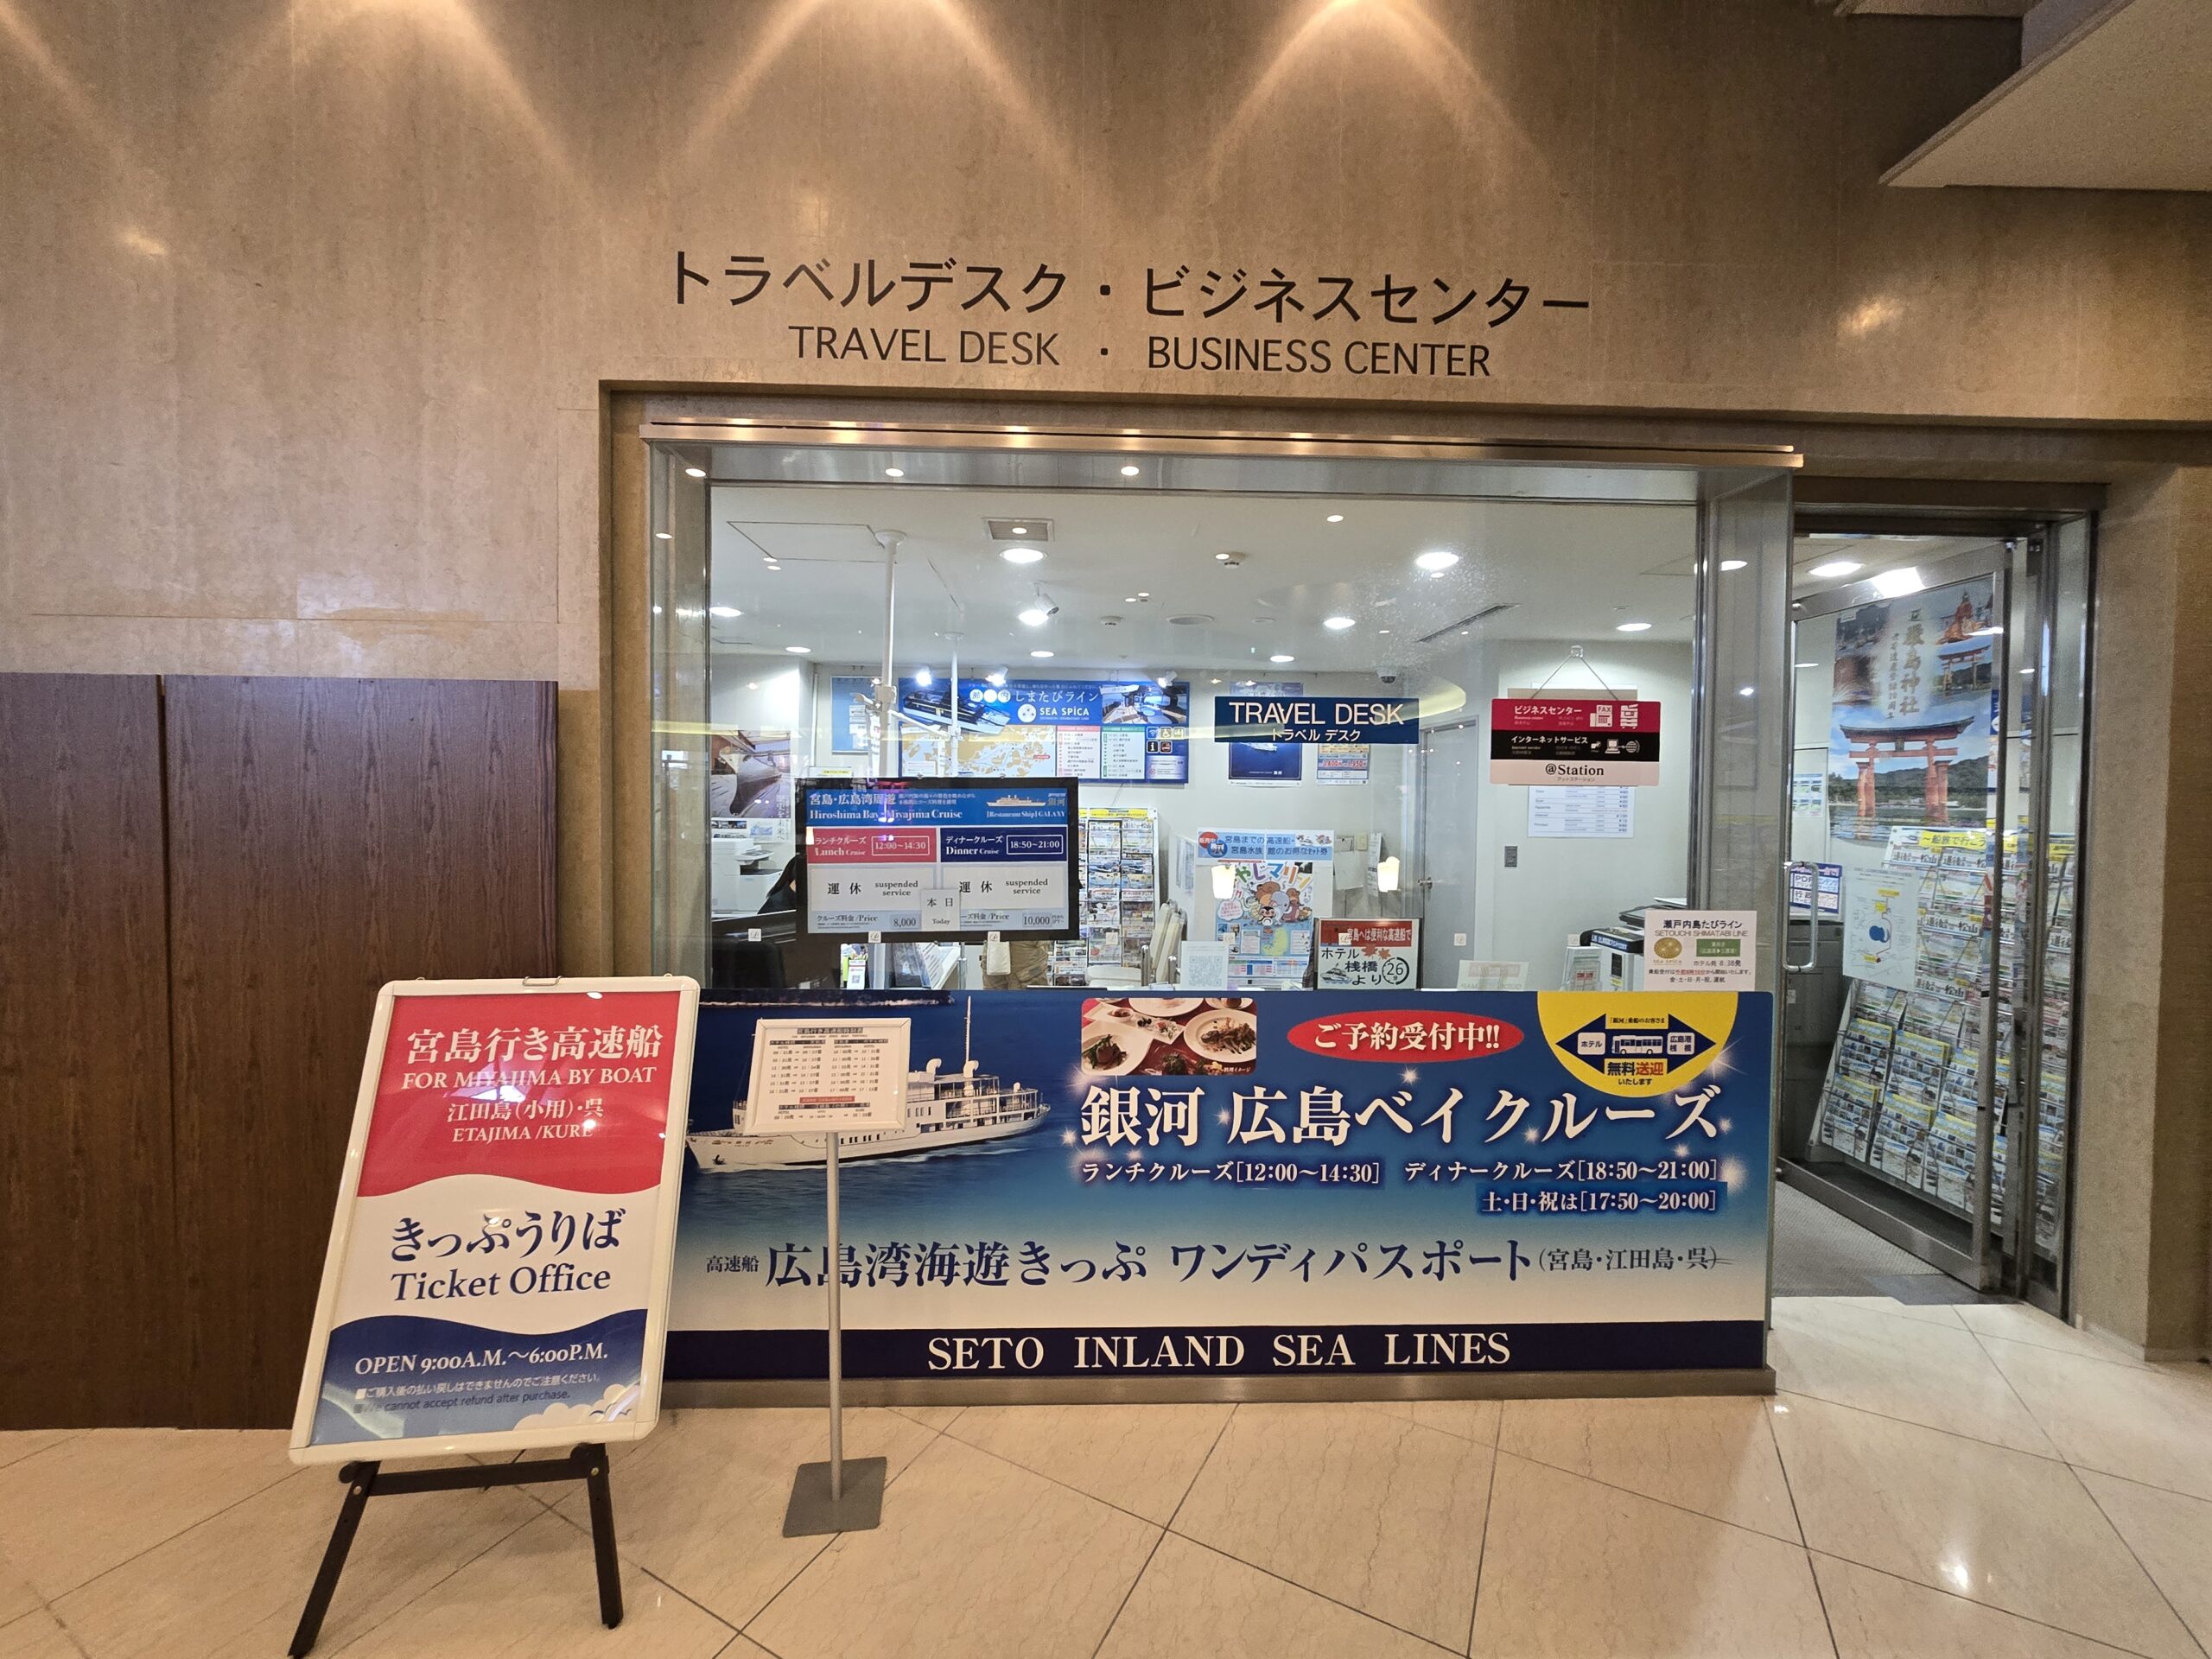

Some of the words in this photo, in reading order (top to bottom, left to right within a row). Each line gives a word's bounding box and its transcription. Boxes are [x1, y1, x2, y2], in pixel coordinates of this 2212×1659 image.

[788, 325, 947, 363] TRAVEL
[959, 330, 1061, 366] DESK
[1148, 335, 1332, 373] BUSINESS
[1344, 340, 1491, 378] CENTER
[1039, 707, 1058, 716] SEA
[1228, 702, 1325, 725] TRAVEL
[1335, 702, 1404, 726] DESK
[1514, 705, 1582, 715] ビジネスセンター
[1273, 728, 1320, 741] トラベル
[1325, 729, 1362, 742] デスク
[1511, 735, 1588, 744] インターネットサービス
[1545, 763, 1605, 776] @Station
[810, 810, 861, 819] Hiroshima
[931, 809, 963, 819] Cruise
[815, 836, 867, 845] ランチクルーズ
[945, 835, 1003, 845] ディナークルーズ
[815, 847, 844, 856] Lunch
[946, 846, 978, 855] Dinner
[874, 880, 918, 889] suspended
[1005, 878, 1049, 888] suspended
[893, 917, 917, 928] 8,000
[931, 918, 950, 927] Today
[1022, 914, 1051, 926] 10,000
[1662, 919, 1743, 929] 瀬戸内島たびライン
[1321, 948, 1359, 959] ホテル
[1344, 961, 1378, 973] 桟橋
[1386, 963, 1404, 976] 26
[1351, 974, 1382, 986] より
[406, 1024, 664, 1065] 宮島行き高速船
[1669, 1035, 1692, 1044] 広島港
[1607, 1061, 1664, 1077] 無料送迎
[401, 1071, 448, 1090] FOR
[454, 1068, 561, 1090] MIYAJIMA
[567, 1068, 596, 1085] BY
[599, 1065, 658, 1084] BOAT
[1081, 1084, 1205, 1147] 銀河
[451, 1125, 531, 1146] ETAJIMA
[391, 1207, 626, 1262] きっぷうりば
[706, 1255, 760, 1274] 高速船
[765, 1240, 1148, 1288] 広島湾海遊きっぷ
[1170, 1238, 1532, 1284] ワンディパスポート
[391, 1268, 500, 1302] Ticket
[508, 1262, 612, 1295] Office
[927, 1336, 1046, 1371] SETO
[1073, 1333, 1245, 1370] INLAND
[1272, 1333, 1357, 1368] SEA
[1383, 1332, 1511, 1367] LINES
[354, 1353, 417, 1376] OPEN
[384, 1399, 421, 1413] cannot
[423, 1397, 458, 1410] accept
[461, 1394, 493, 1406] refund
[496, 1391, 520, 1404] after
[522, 1389, 571, 1404] purchase.
